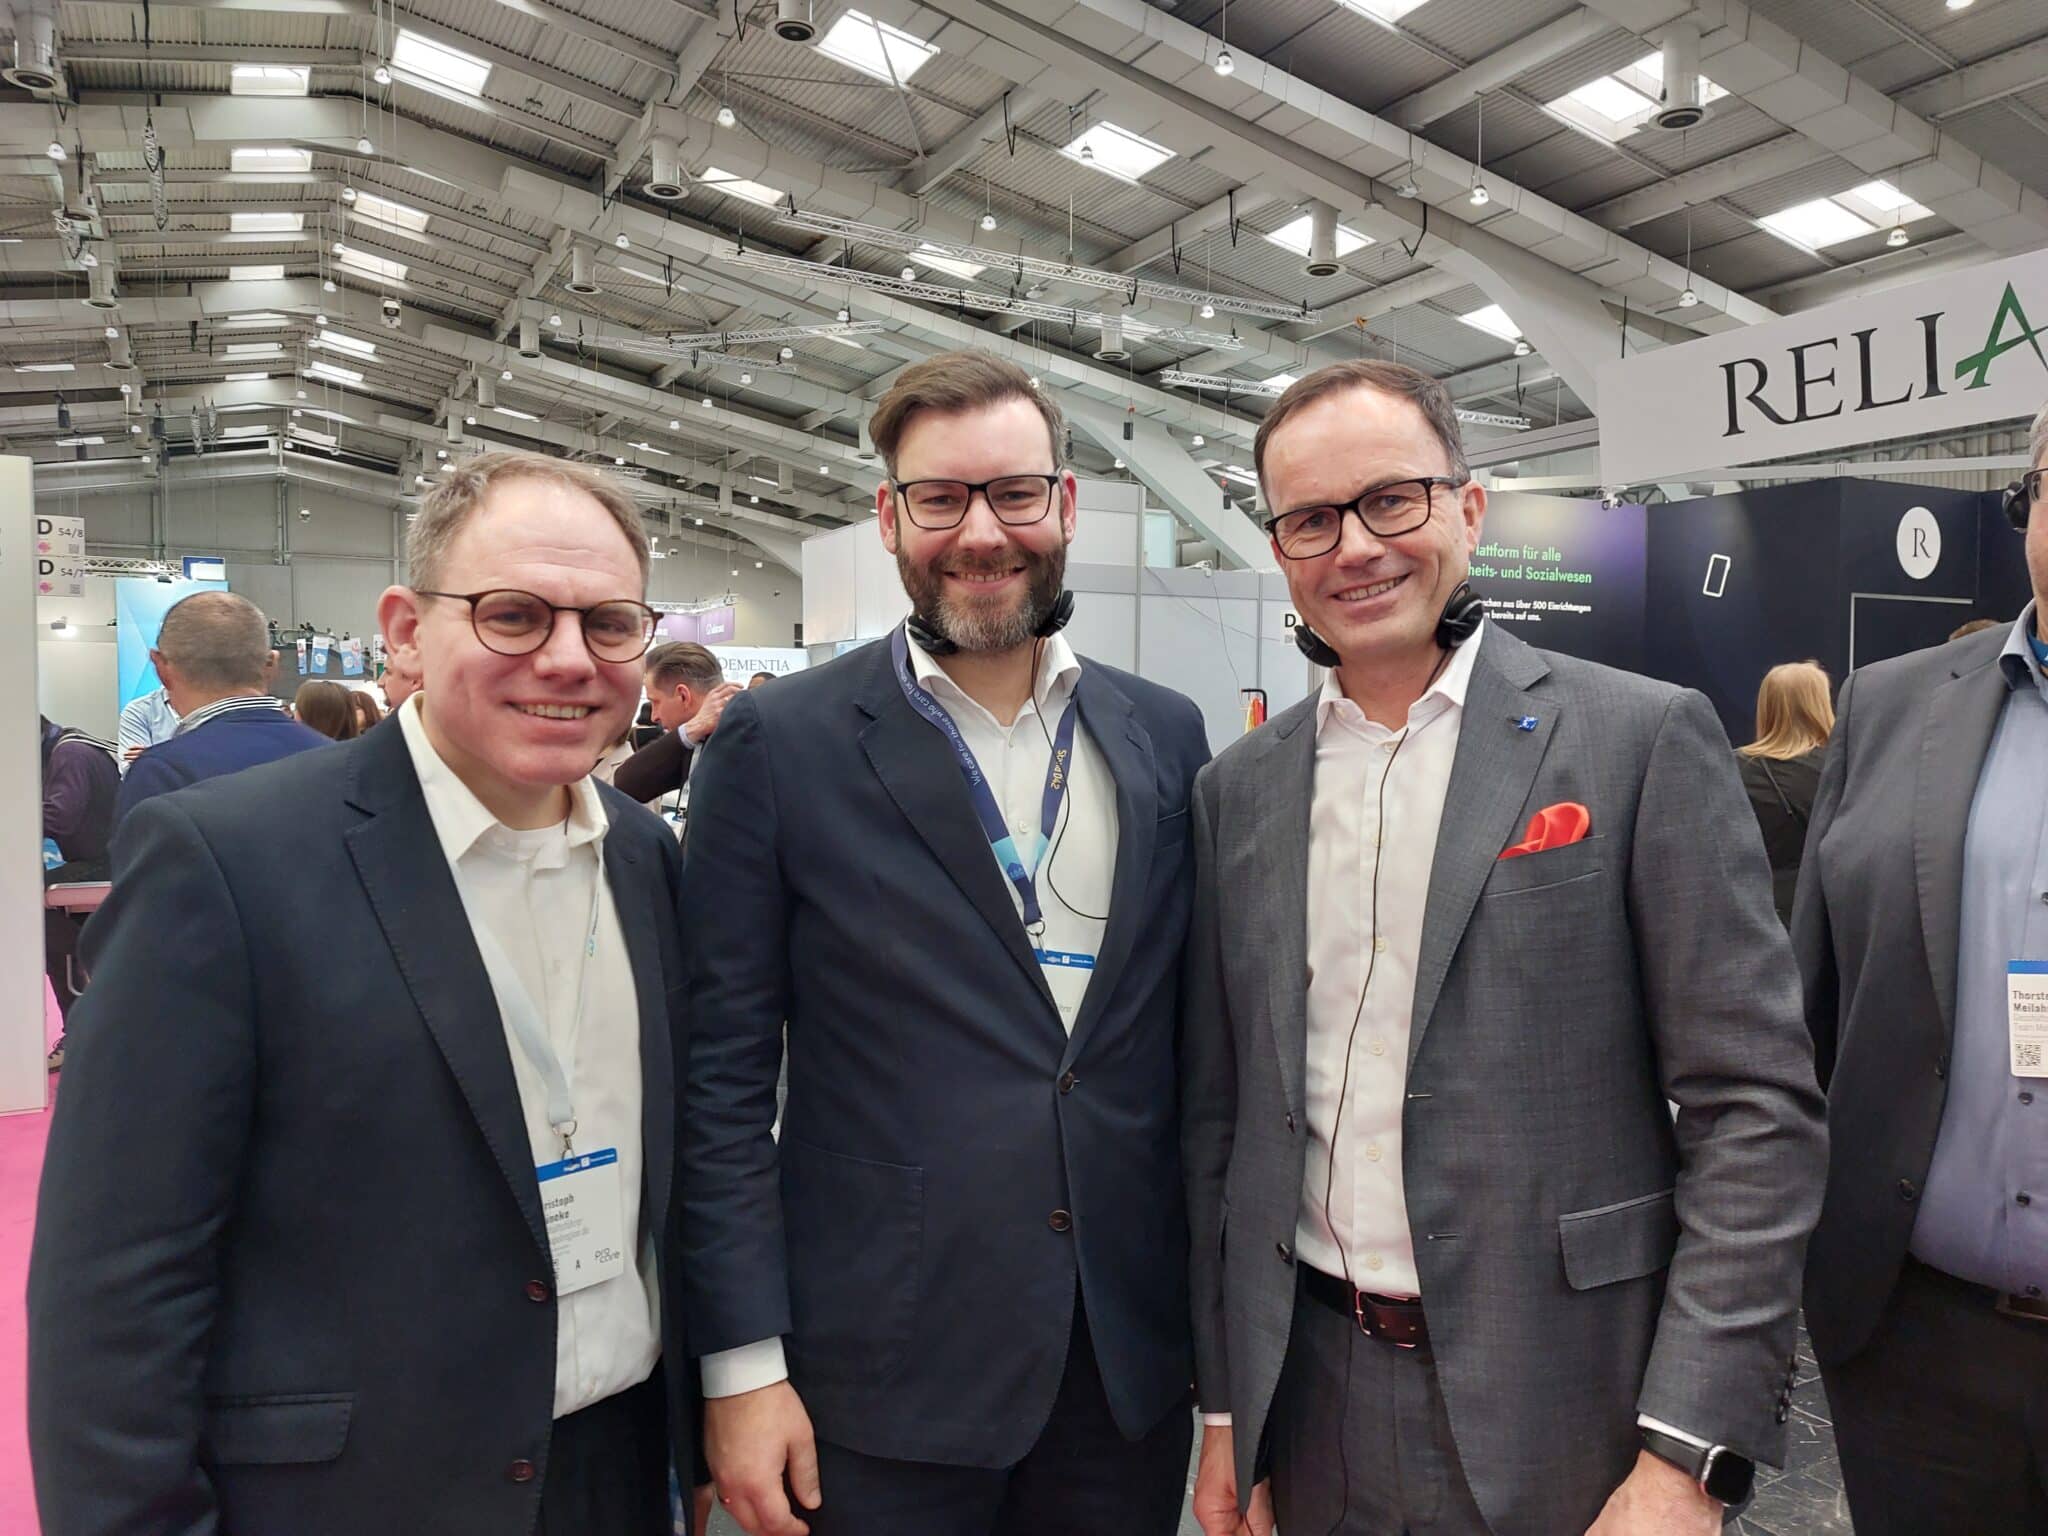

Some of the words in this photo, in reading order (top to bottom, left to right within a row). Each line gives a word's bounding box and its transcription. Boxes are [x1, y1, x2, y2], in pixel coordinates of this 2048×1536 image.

[37, 519, 53, 535] D
[1912, 528, 1932, 559] R
[1523, 544, 1539, 560] für
[1542, 546, 1562, 562] alle
[39, 559, 54, 576] D
[1501, 564, 1522, 579] und
[1526, 566, 1592, 584] Sozialwesen
[1491, 609, 1514, 620] bereits
[1516, 611, 1526, 621] auf
[1533, 600, 1547, 611] 500
[1548, 601, 1592, 614] Einrichtungen
[1284, 613, 1297, 628] D
[913, 692, 930, 706] care
[928, 705, 944, 720] who
[942, 718, 959, 739] those
[962, 752, 975, 769] care
[970, 770, 981, 786] We
[2014, 1002, 2048, 1013] Meilah
